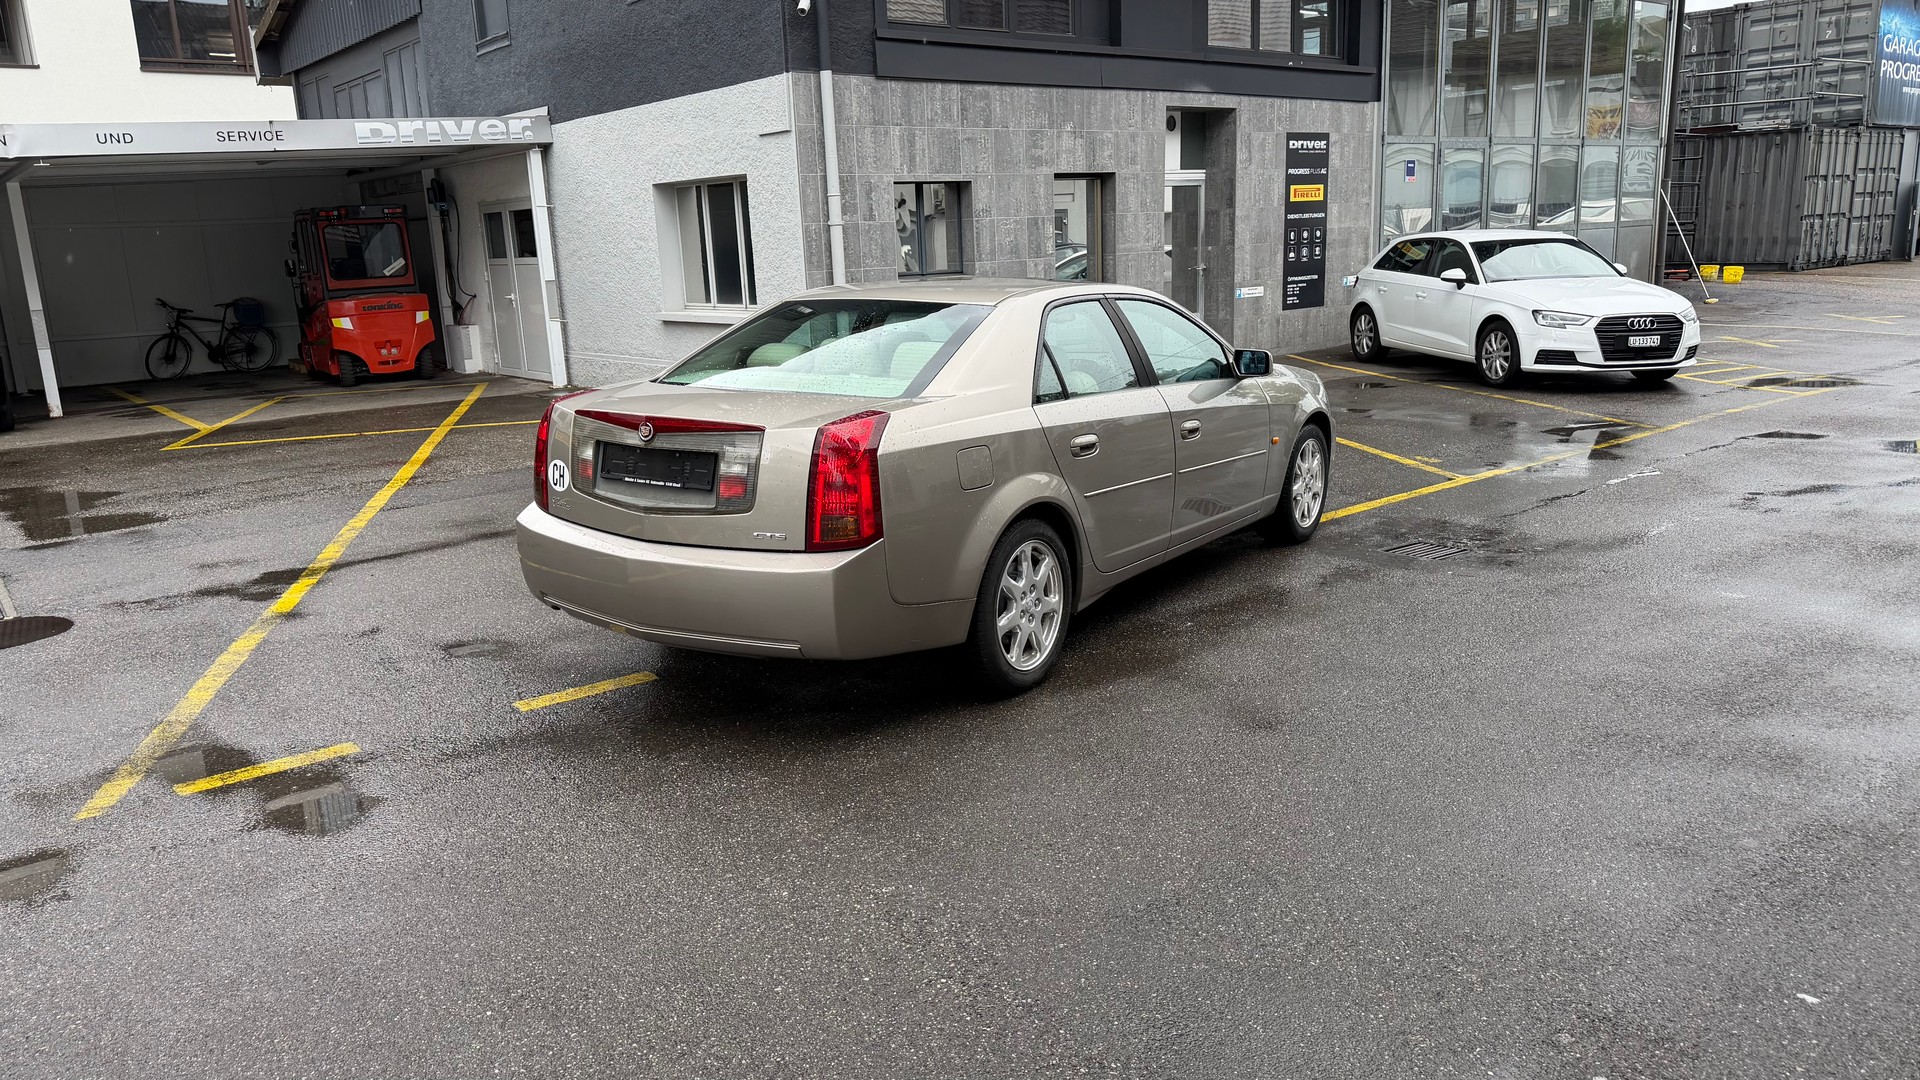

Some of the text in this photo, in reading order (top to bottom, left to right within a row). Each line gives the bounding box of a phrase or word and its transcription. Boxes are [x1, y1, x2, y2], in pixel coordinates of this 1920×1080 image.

[96, 132, 134, 144] UND
[216, 130, 285, 142] SERVICE
[1293, 187, 1321, 198] PIRELLI
[552, 463, 565, 488] CH
[753, 532, 787, 540] CTS
